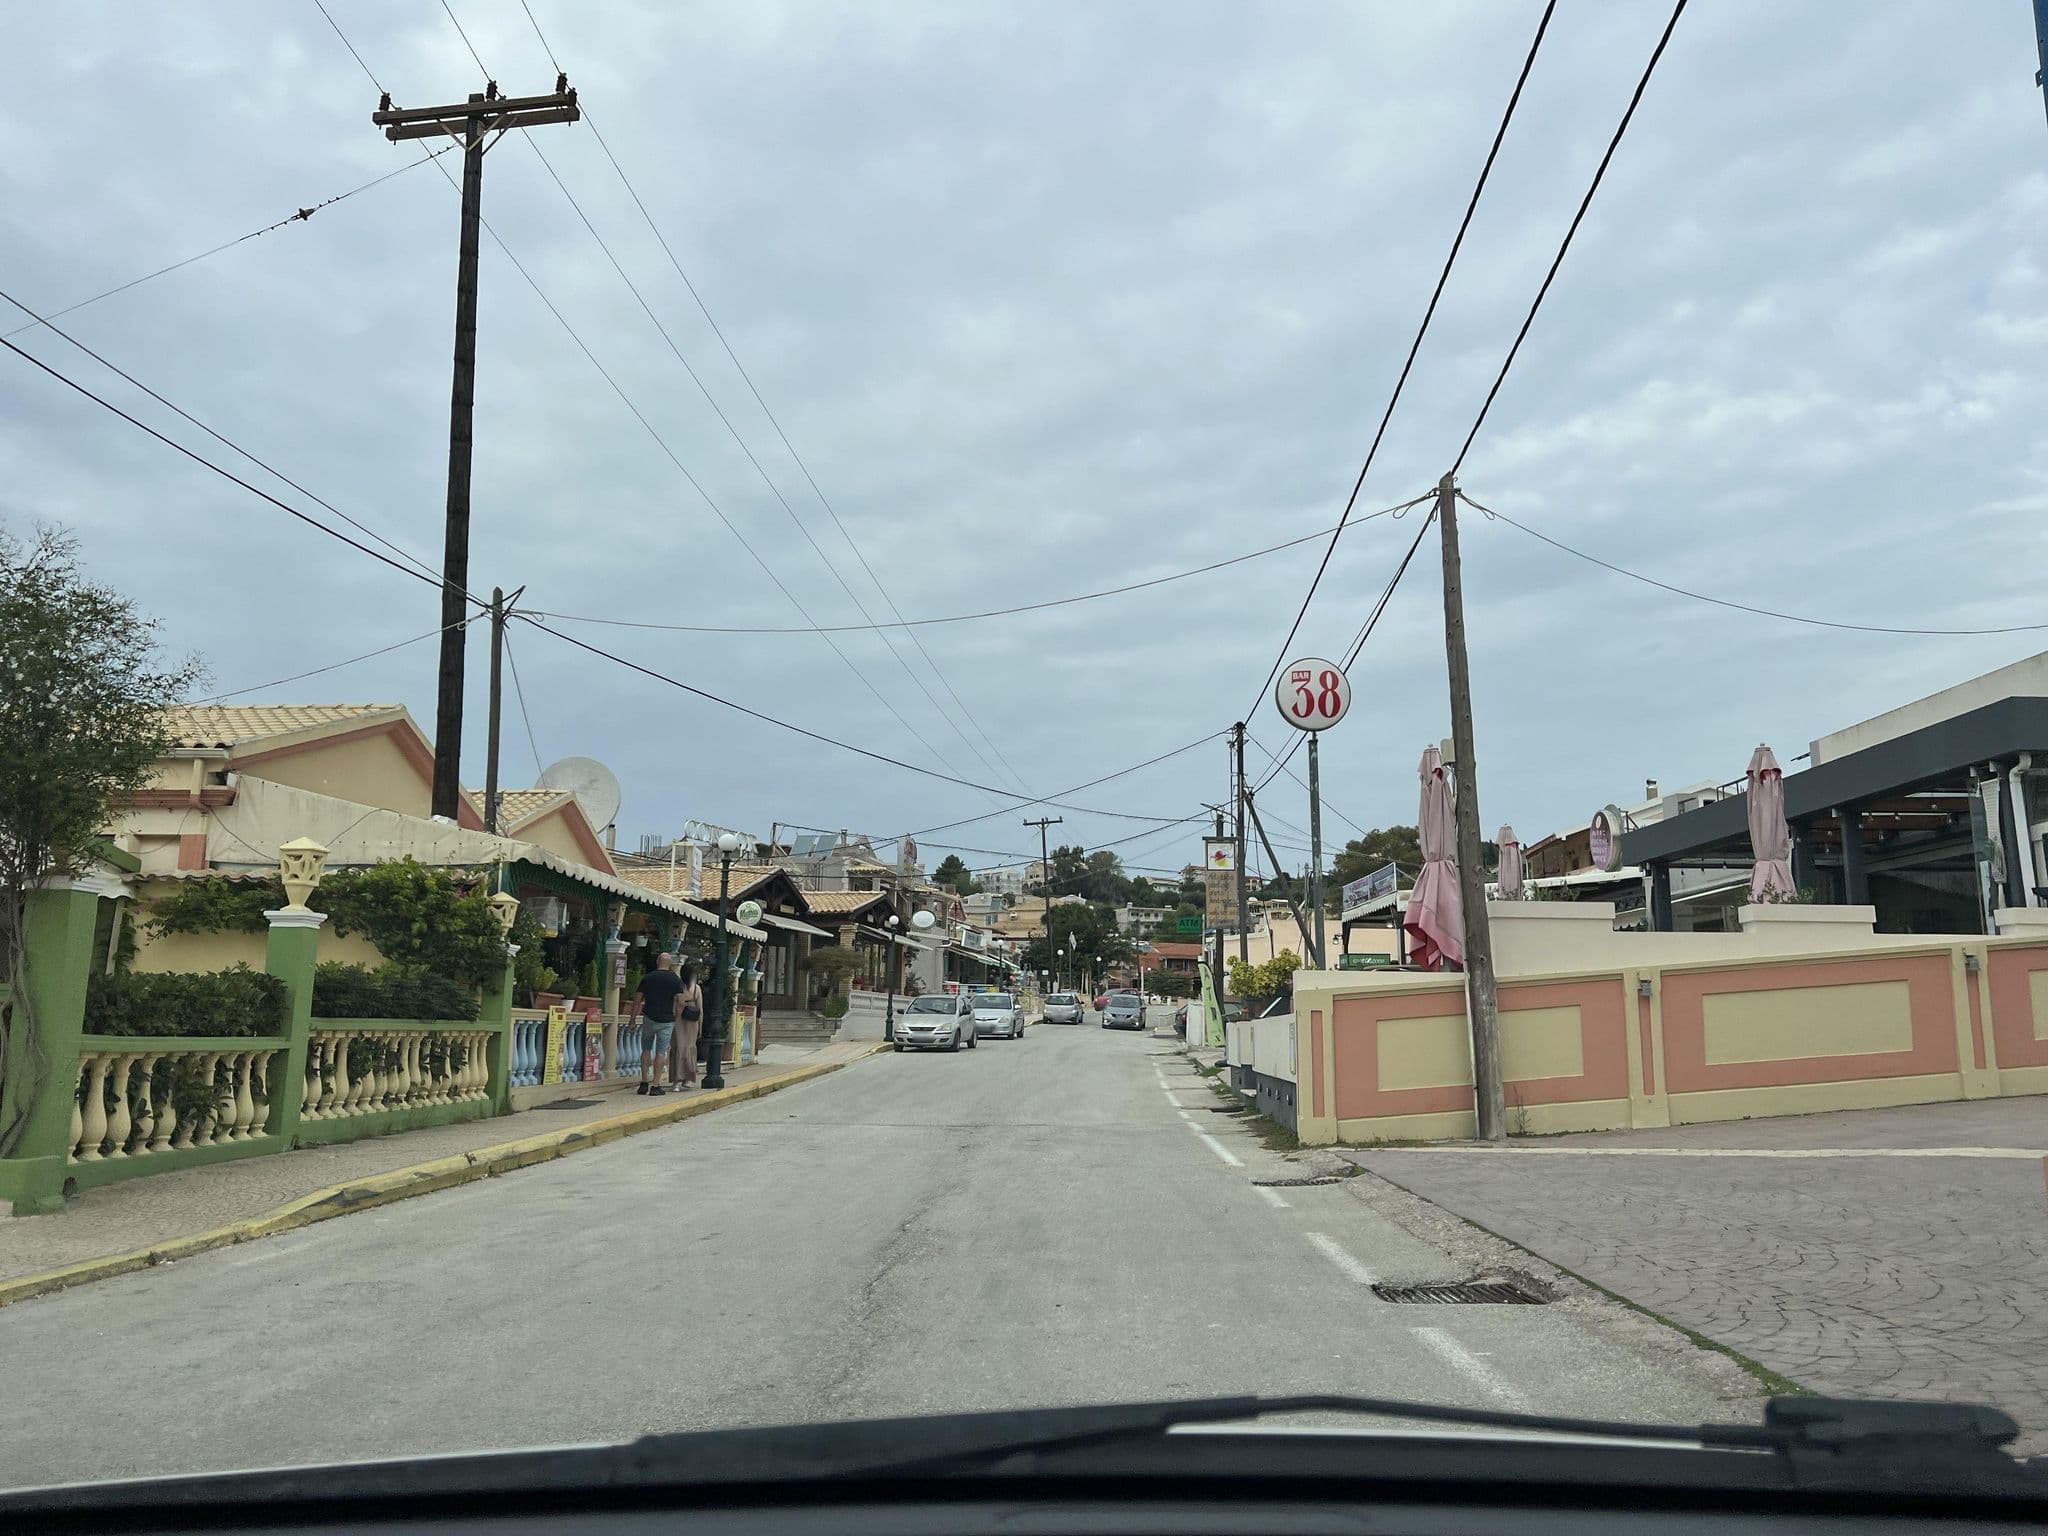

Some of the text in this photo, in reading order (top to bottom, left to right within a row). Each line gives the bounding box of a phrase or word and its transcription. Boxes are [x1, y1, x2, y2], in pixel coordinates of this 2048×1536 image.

[1292, 672, 1310, 680] BAR
[1291, 670, 1341, 719] 38
[1179, 919, 1200, 928] ATM
